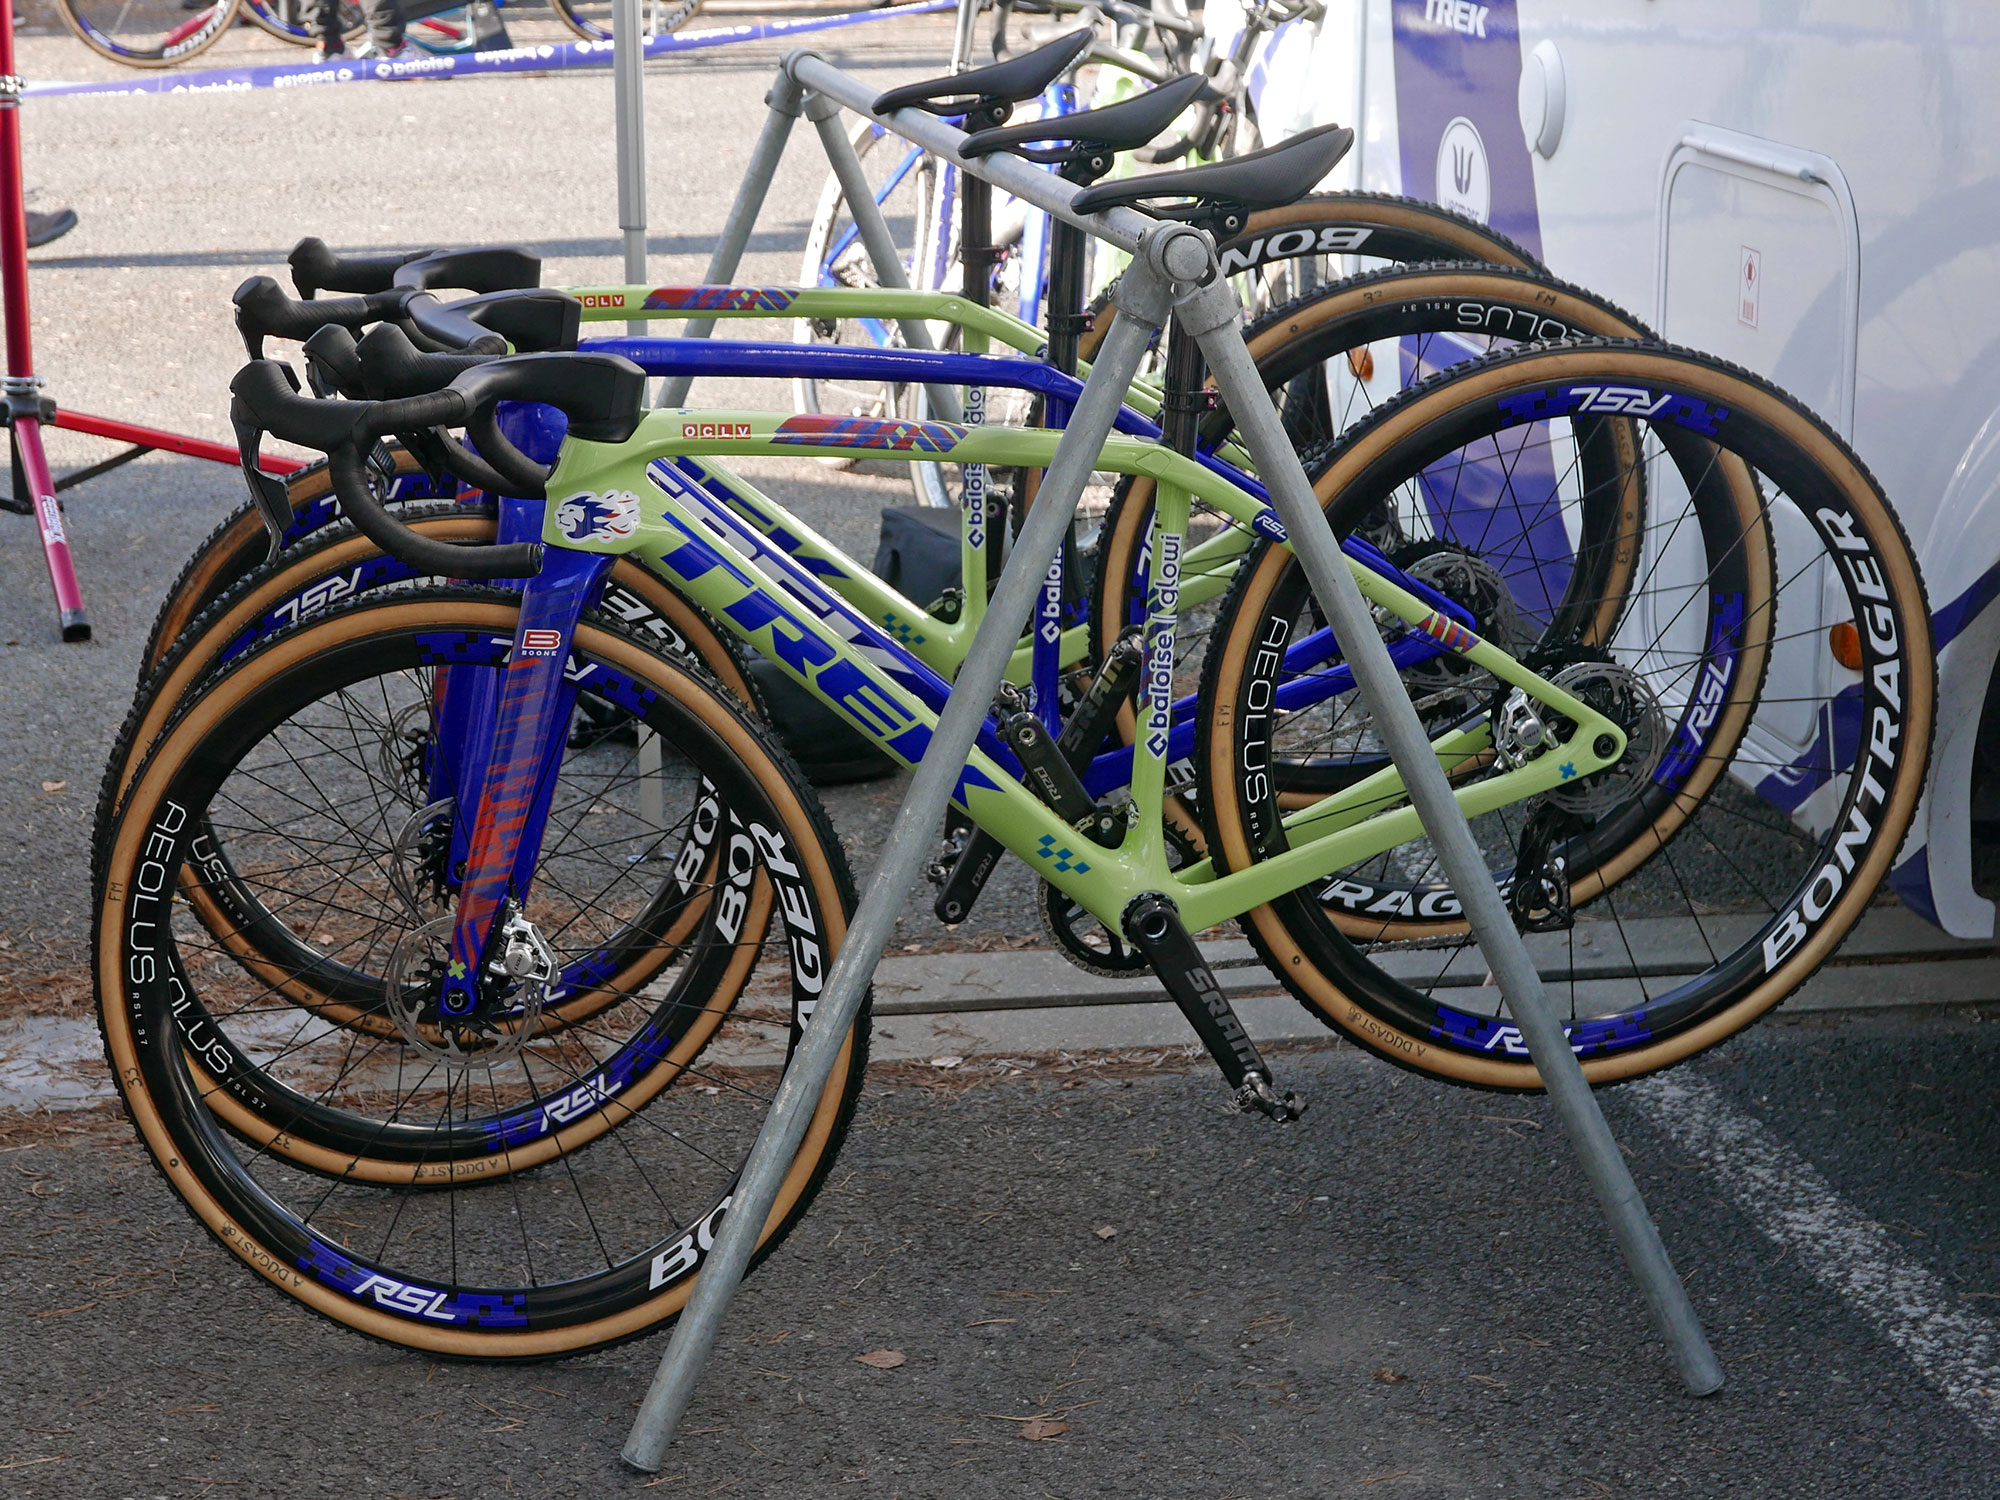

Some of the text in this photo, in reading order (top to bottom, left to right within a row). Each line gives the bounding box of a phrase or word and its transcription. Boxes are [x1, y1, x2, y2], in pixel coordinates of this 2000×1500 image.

[1424, 0, 1490, 39] TREK
[394, 56, 455, 75] baloise
[579, 295, 625, 307] CLV
[1570, 387, 1672, 415] RSL
[684, 424, 750, 440] OCLV
[1156, 534, 1180, 606] glowi
[274, 566, 363, 621] RSL
[522, 630, 561, 649] B
[660, 511, 1006, 810] TREK
[1149, 632, 1174, 730] baloise
[1243, 616, 1289, 804] AEOLUS
[1686, 656, 1733, 747] RSL
[1763, 507, 1901, 974] BONTRAGER
[1250, 812, 1260, 839] RSL
[109, 882, 123, 902] FM
[130, 801, 187, 1045] AEOLUS RSL 37
[1359, 1016, 1427, 1057] A DUGAST
[1485, 1027, 1583, 1054] RL
[125, 1067, 143, 1089] 33
[540, 1073, 622, 1132] RSL
[429, 1158, 498, 1178] A DUGAST
[236, 1236, 304, 1287] A DUGAST
[352, 1275, 456, 1321] RSL
